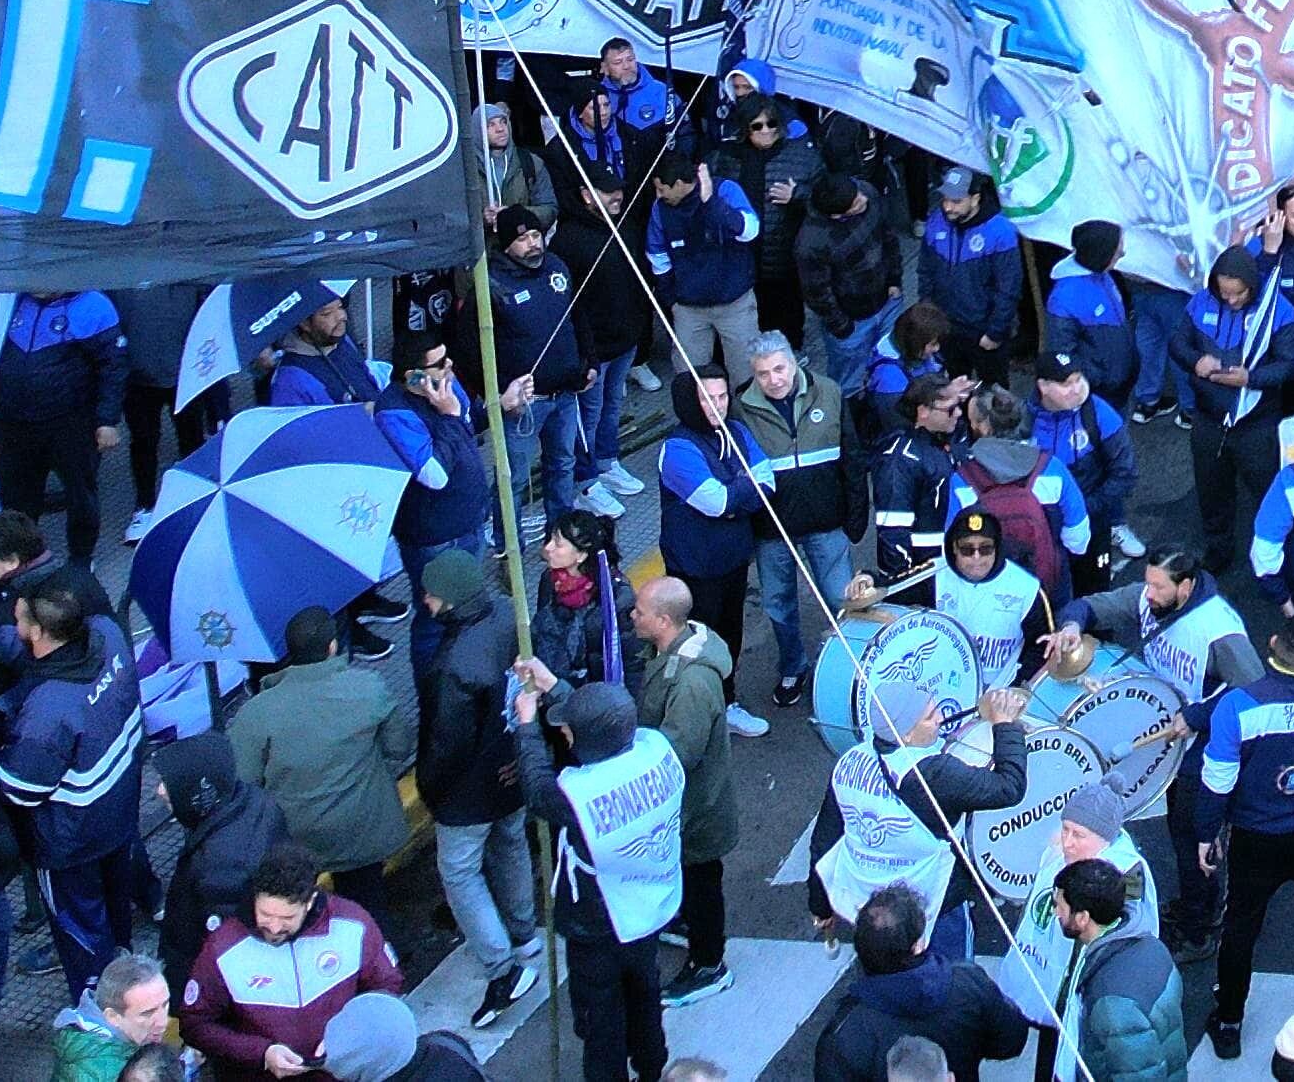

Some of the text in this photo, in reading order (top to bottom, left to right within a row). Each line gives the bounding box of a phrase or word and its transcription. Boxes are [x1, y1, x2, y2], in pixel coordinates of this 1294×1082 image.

[894, 16, 902, 28] Y
[232, 24, 414, 182] CATT
[1125, 687, 1168, 714] BREY
[1064, 743, 1092, 775] BREY
